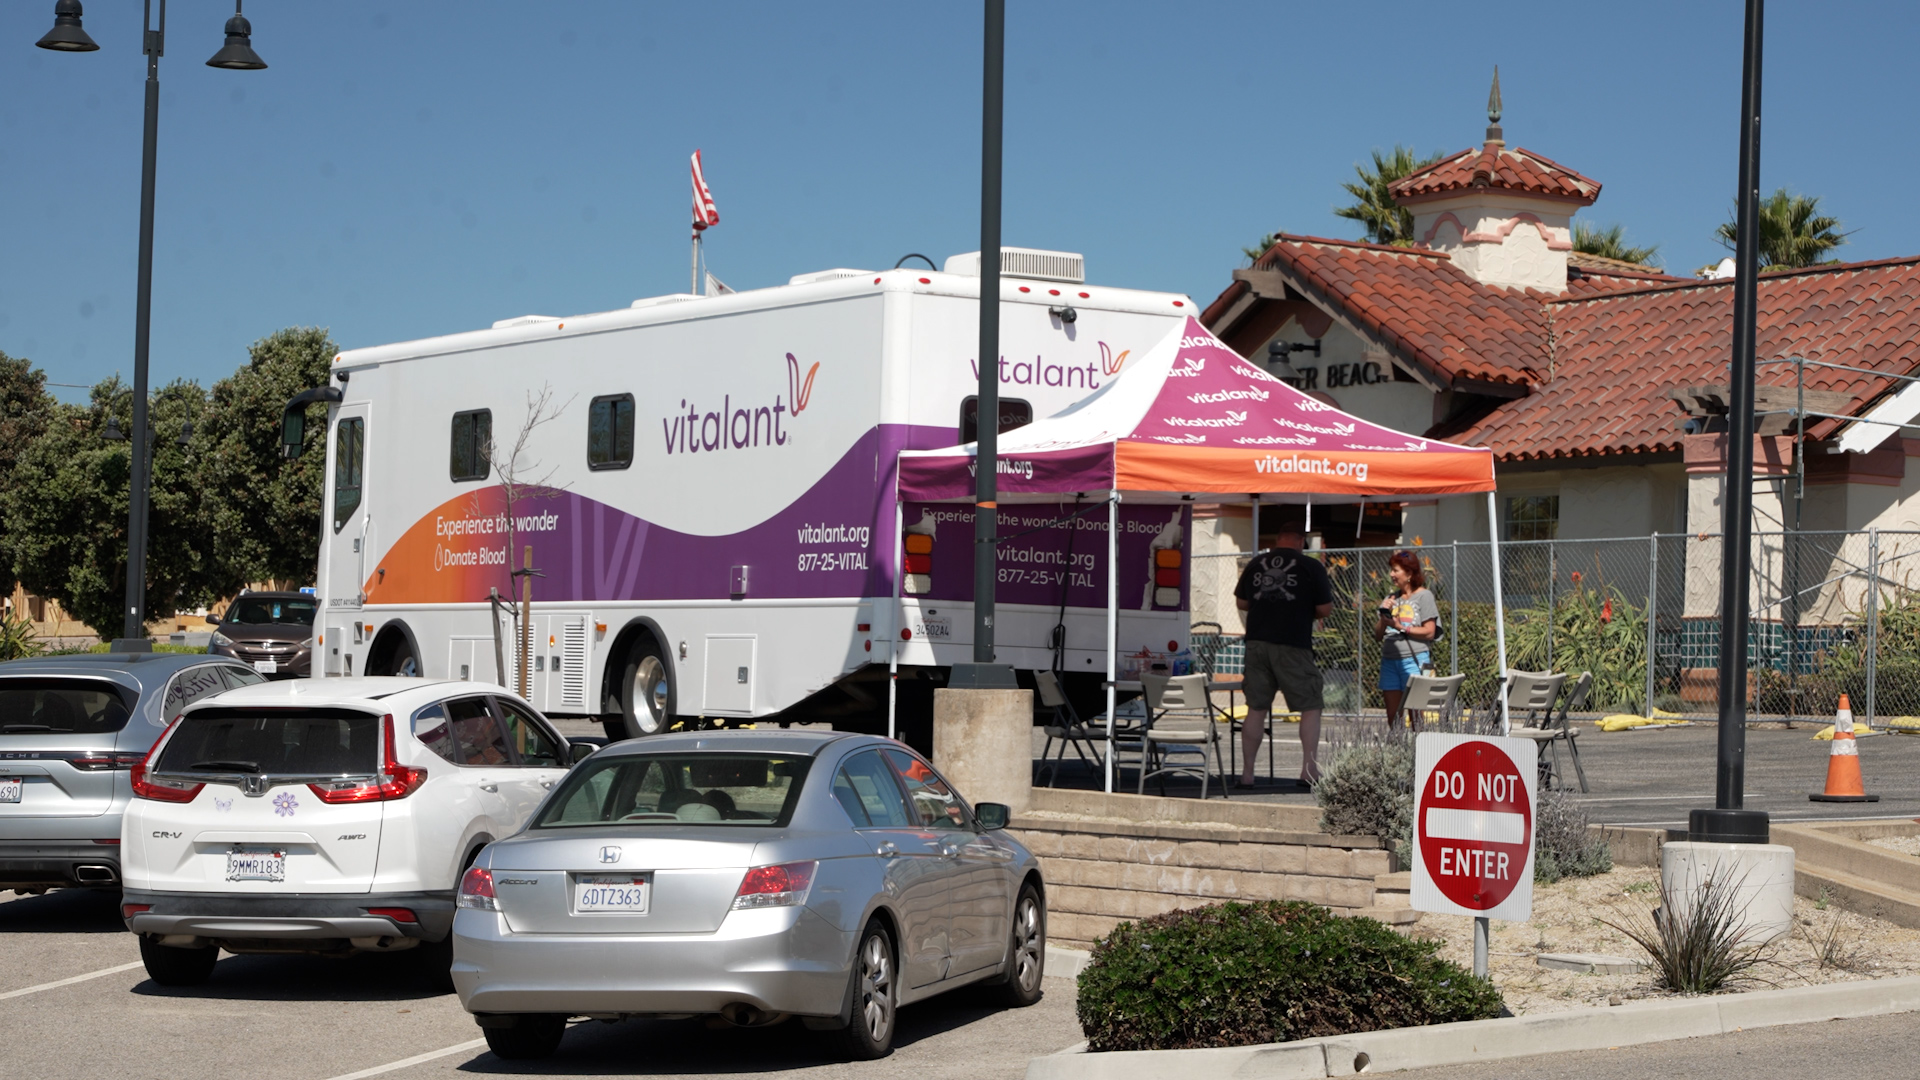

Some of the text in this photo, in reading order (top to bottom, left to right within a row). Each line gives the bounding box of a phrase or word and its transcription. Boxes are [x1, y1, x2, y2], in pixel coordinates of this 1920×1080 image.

[970, 354, 1100, 389] vtalant
[1186, 389, 1264, 404] vitalant
[663, 394, 786, 455] vitalant
[1163, 416, 1240, 428] vitalant
[1273, 418, 1349, 437] vitalant
[1232, 435, 1311, 446] vitalant
[967, 458, 1033, 480] vint.org
[1254, 455, 1368, 482] vitalant.org
[436, 515, 494, 541] Experience
[516, 509, 559, 532] wonder
[996, 513, 1019, 526] the
[1076, 518, 1124, 532] Donae
[1127, 520, 1163, 534] Blood
[798, 523, 870, 548] vitalant.org
[444, 546, 506, 566] Donate Blood
[798, 553, 869, 572] 877-25-VITAL
[996, 545, 1095, 571] vitalant.org
[997, 568, 1095, 588] 877-25-VTAL
[1435, 770, 1518, 803] DO NOT
[152, 831, 183, 839] CR-V
[231, 859, 280, 874] 9MMR183
[1440, 846, 1510, 881] ENTER
[582, 888, 641, 905] 6DTZ363
